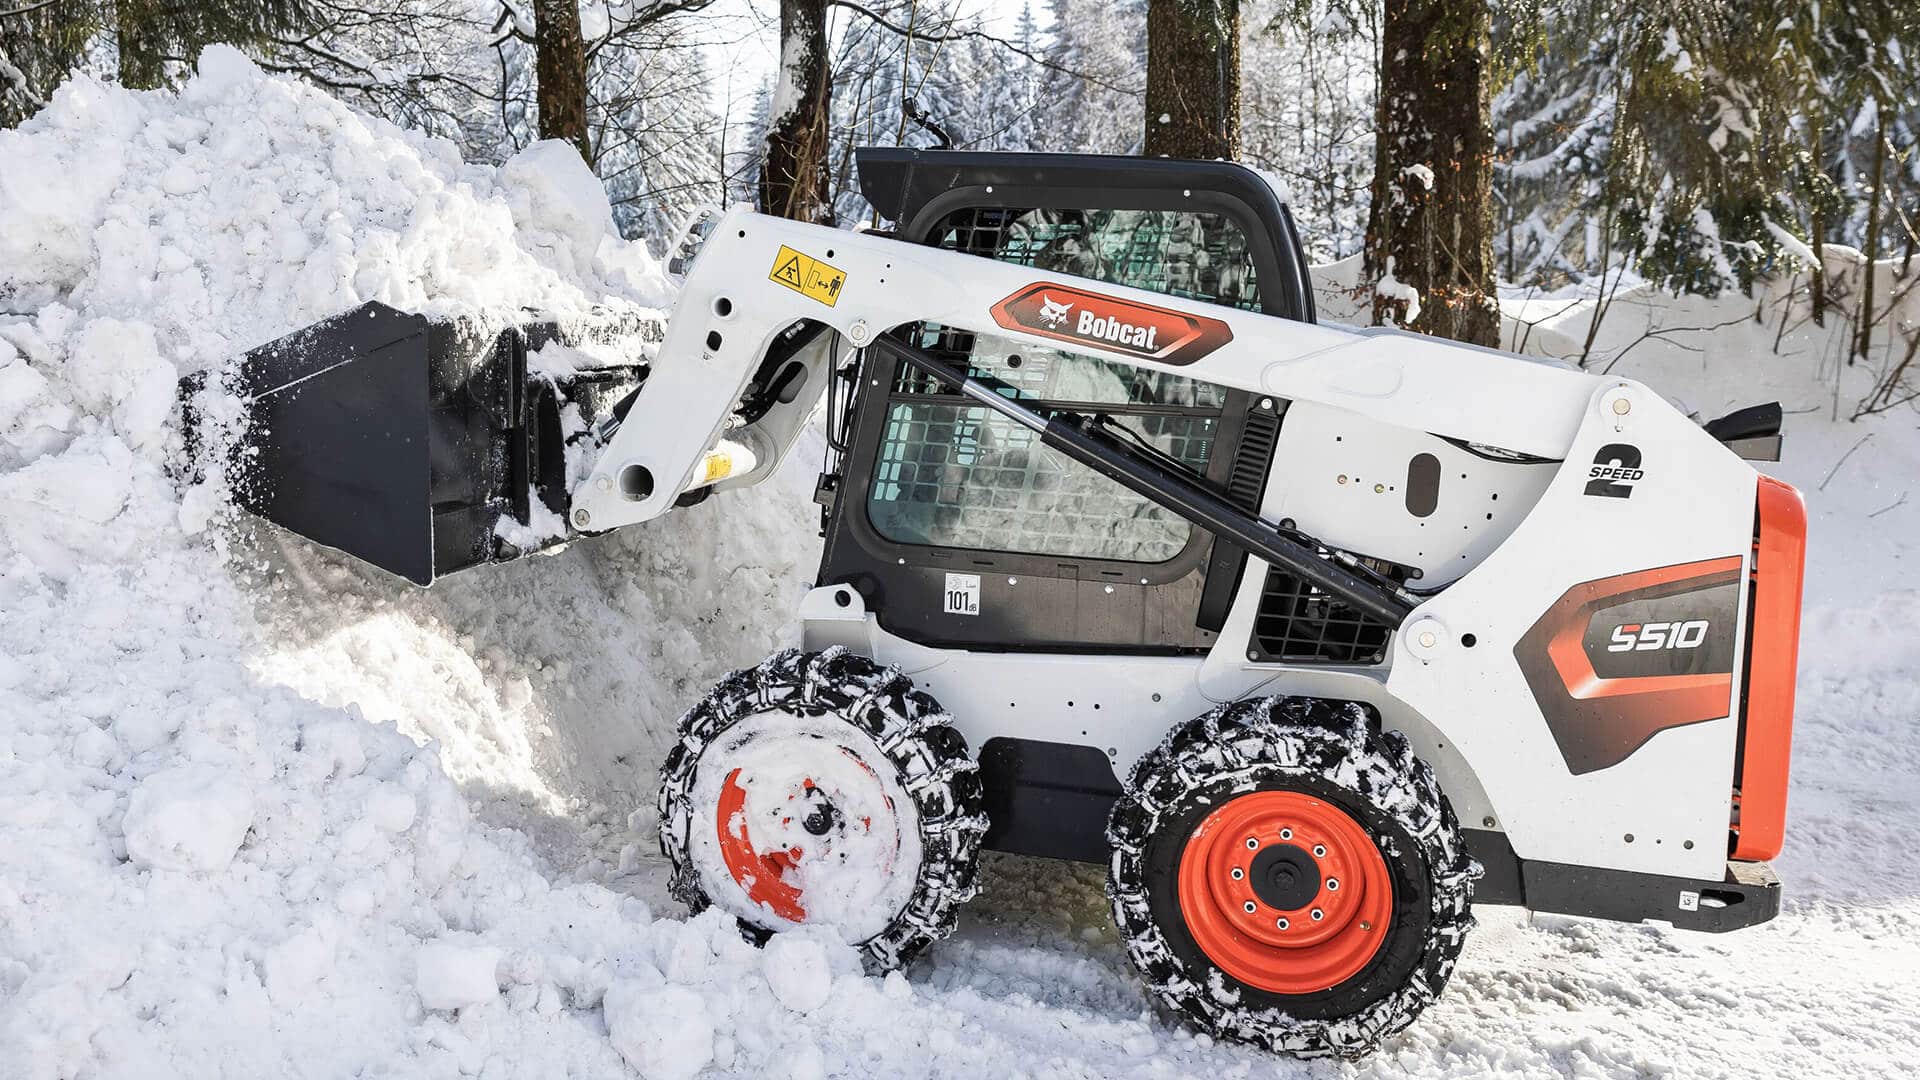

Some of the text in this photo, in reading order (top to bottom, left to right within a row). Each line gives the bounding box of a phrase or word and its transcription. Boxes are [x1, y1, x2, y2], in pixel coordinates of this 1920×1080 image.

[1077, 310, 1157, 349] Bobcat
[1584, 443, 1642, 498] 2
[1589, 466, 1644, 480] SPEED
[948, 591, 969, 610] 101
[1607, 620, 1709, 652] S510
